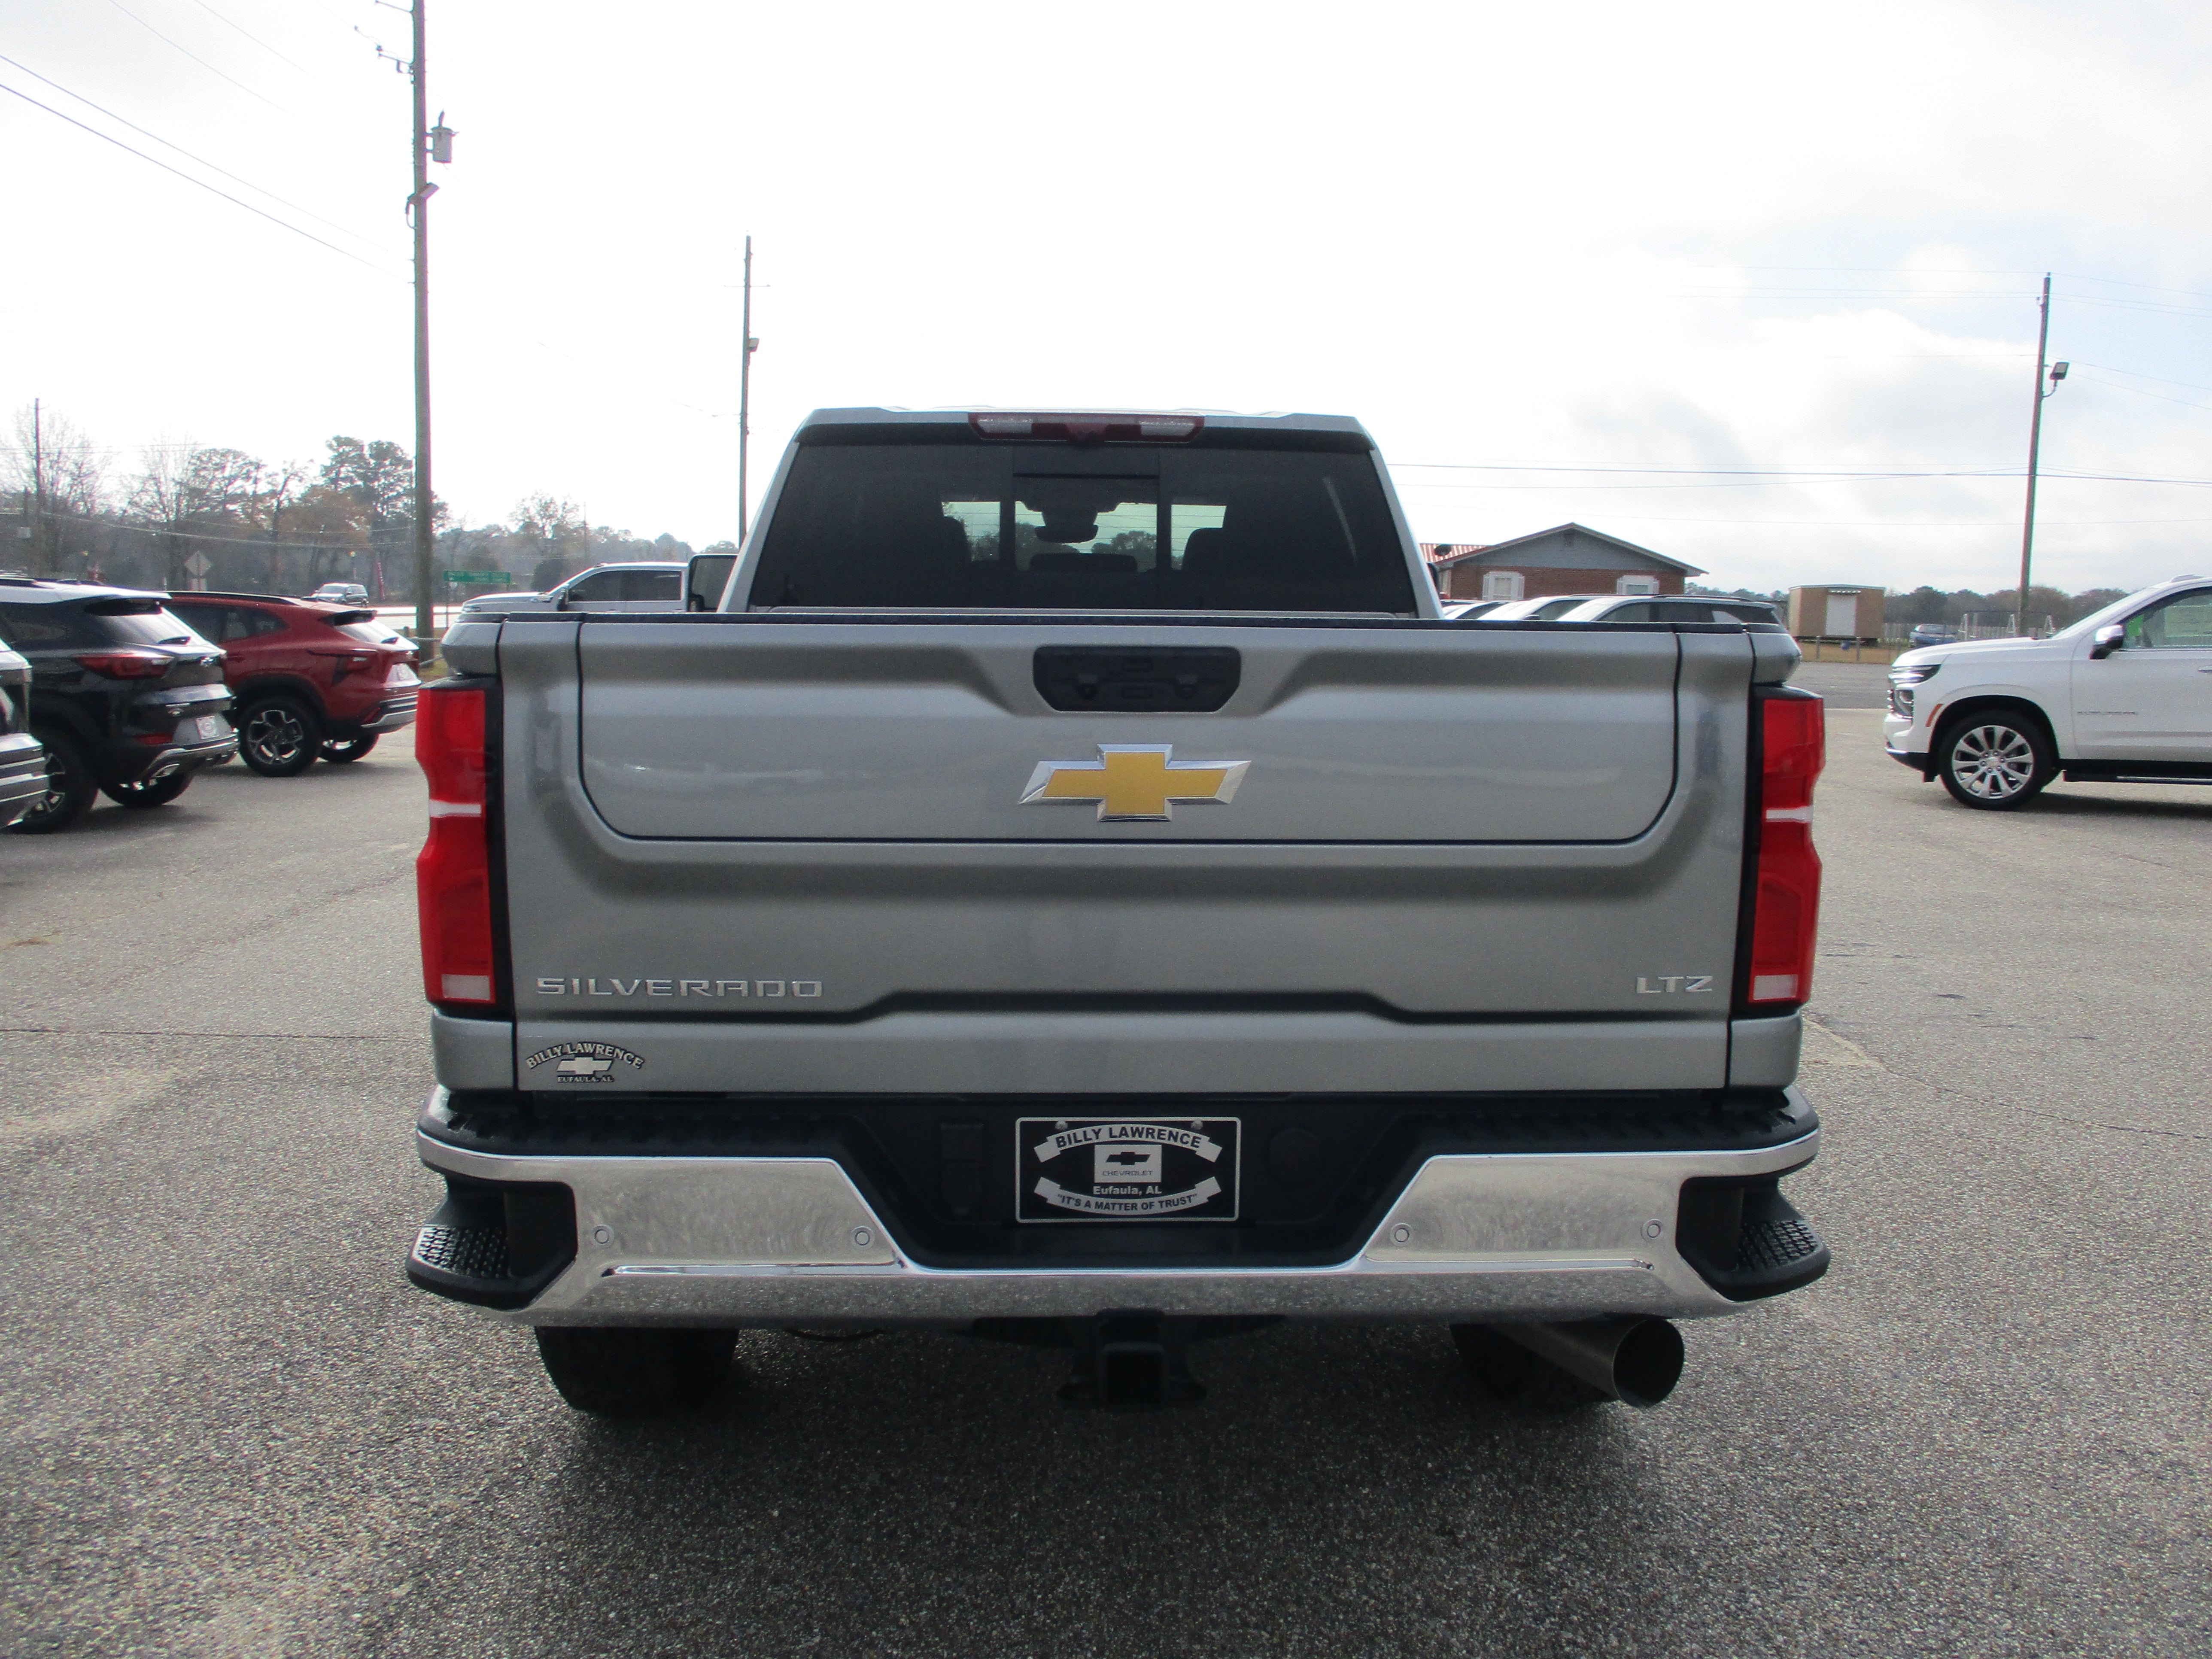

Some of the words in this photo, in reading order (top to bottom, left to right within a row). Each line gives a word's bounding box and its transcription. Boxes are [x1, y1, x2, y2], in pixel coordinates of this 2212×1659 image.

[535, 977, 822, 997] SILVERADO
[1637, 975, 1714, 994] LTZ
[525, 1044, 563, 1069] BILLY
[566, 1042, 645, 1069] LAWRENCE
[1055, 1128, 1102, 1148] BILLY
[1108, 1126, 1202, 1149] LAWRENCE
[1093, 1186, 1142, 1196] Eufaula,
[1146, 1186, 1162, 1194] AL
[1057, 1194, 1082, 1207] "IT'S
[1084, 1200, 1092, 1208] A
[1094, 1201, 1138, 1211] MATTER
[1141, 1201, 1155, 1210] OF
[1158, 1194, 1197, 1208] TRUST"
